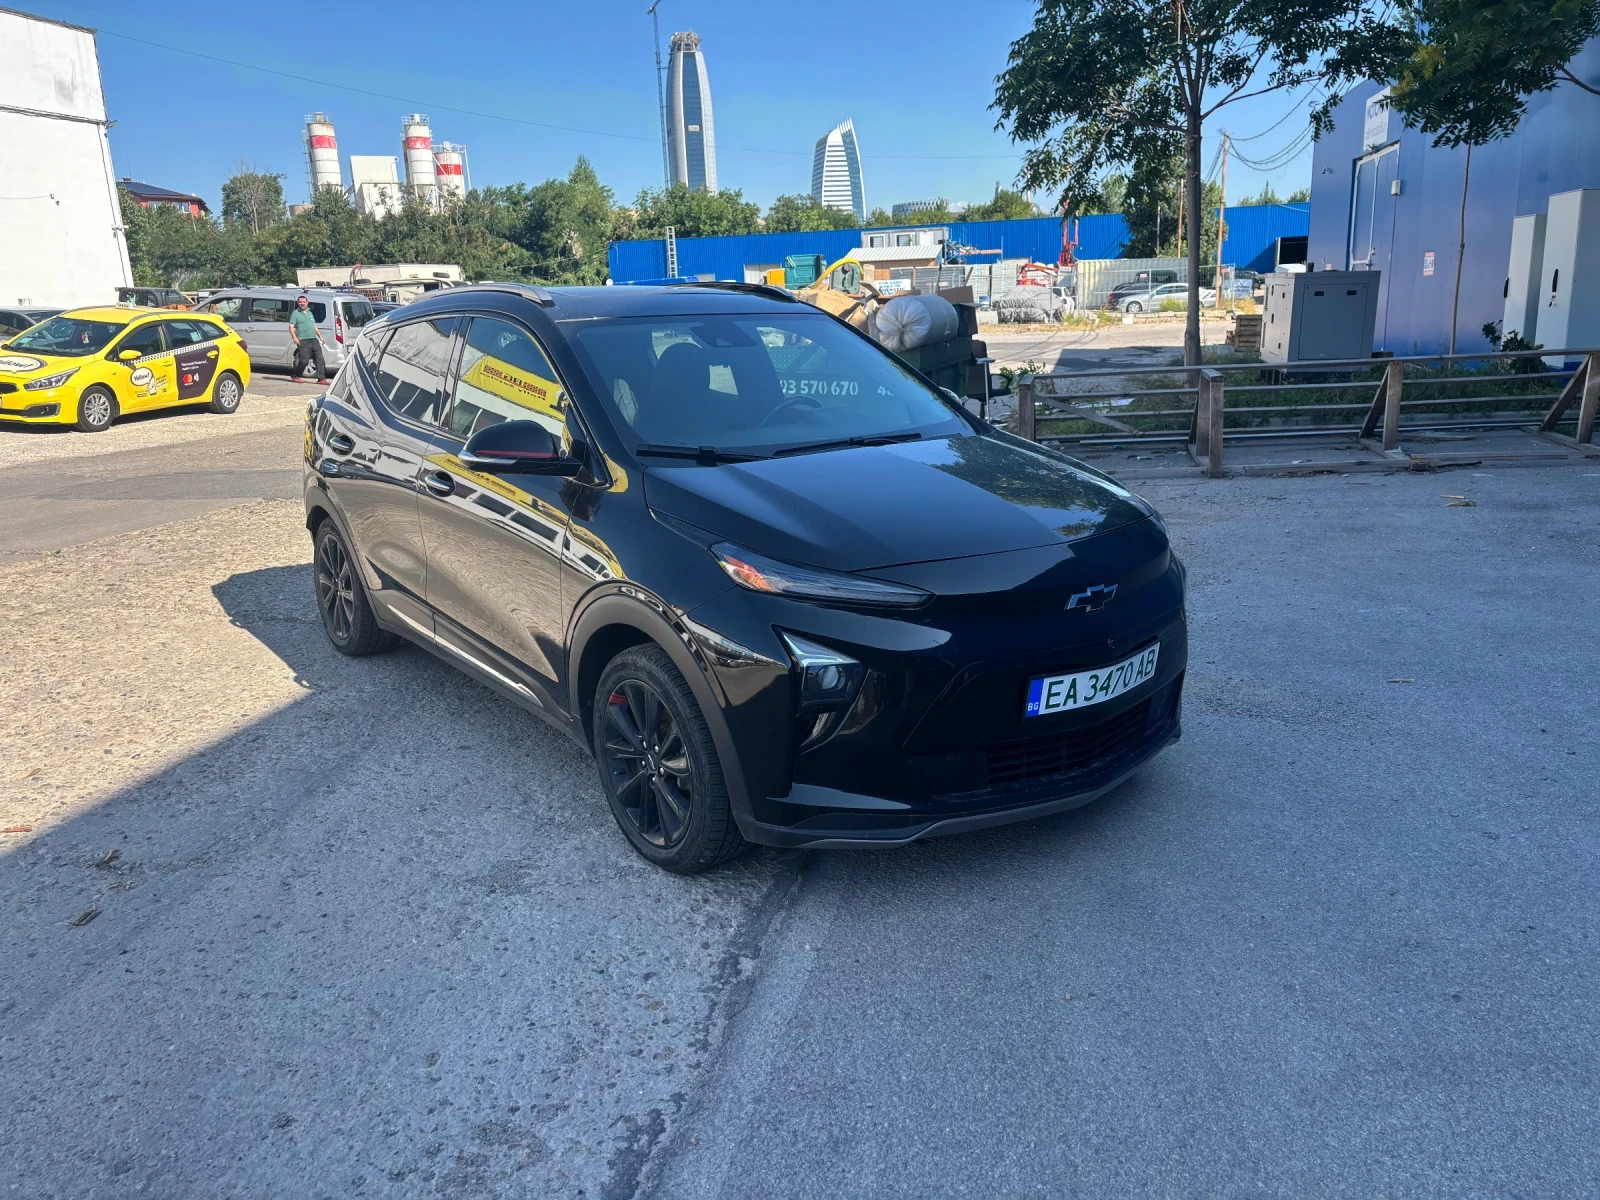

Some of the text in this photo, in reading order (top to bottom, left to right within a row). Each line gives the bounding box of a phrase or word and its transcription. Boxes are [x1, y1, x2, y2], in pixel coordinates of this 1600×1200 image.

[800, 380, 828, 395] 570
[830, 381, 859, 396] 670
[1044, 648, 1156, 710] EA 3470 AB
[1027, 701, 1039, 712] BG
